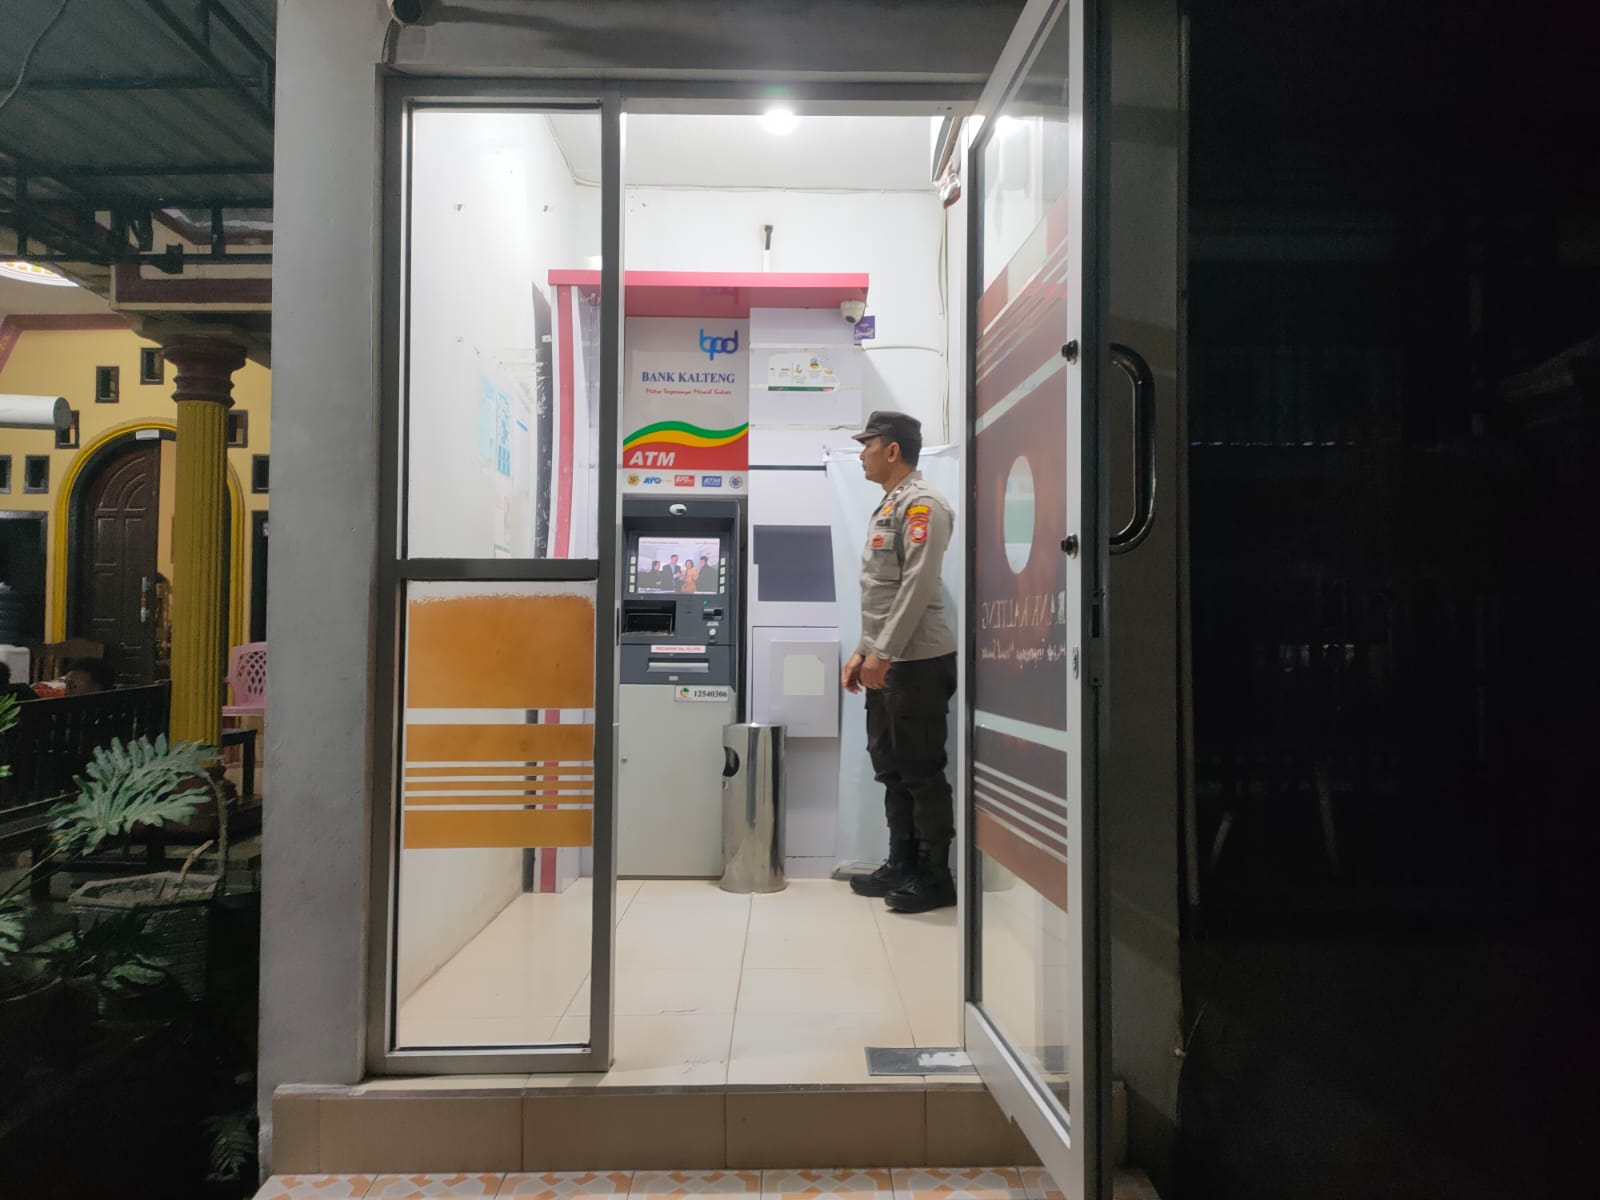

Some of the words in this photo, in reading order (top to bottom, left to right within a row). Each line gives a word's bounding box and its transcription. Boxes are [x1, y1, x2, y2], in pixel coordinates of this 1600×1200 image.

[642, 371, 675, 382] BANK
[678, 372, 735, 383] KALTENG
[629, 451, 675, 466] ATM
